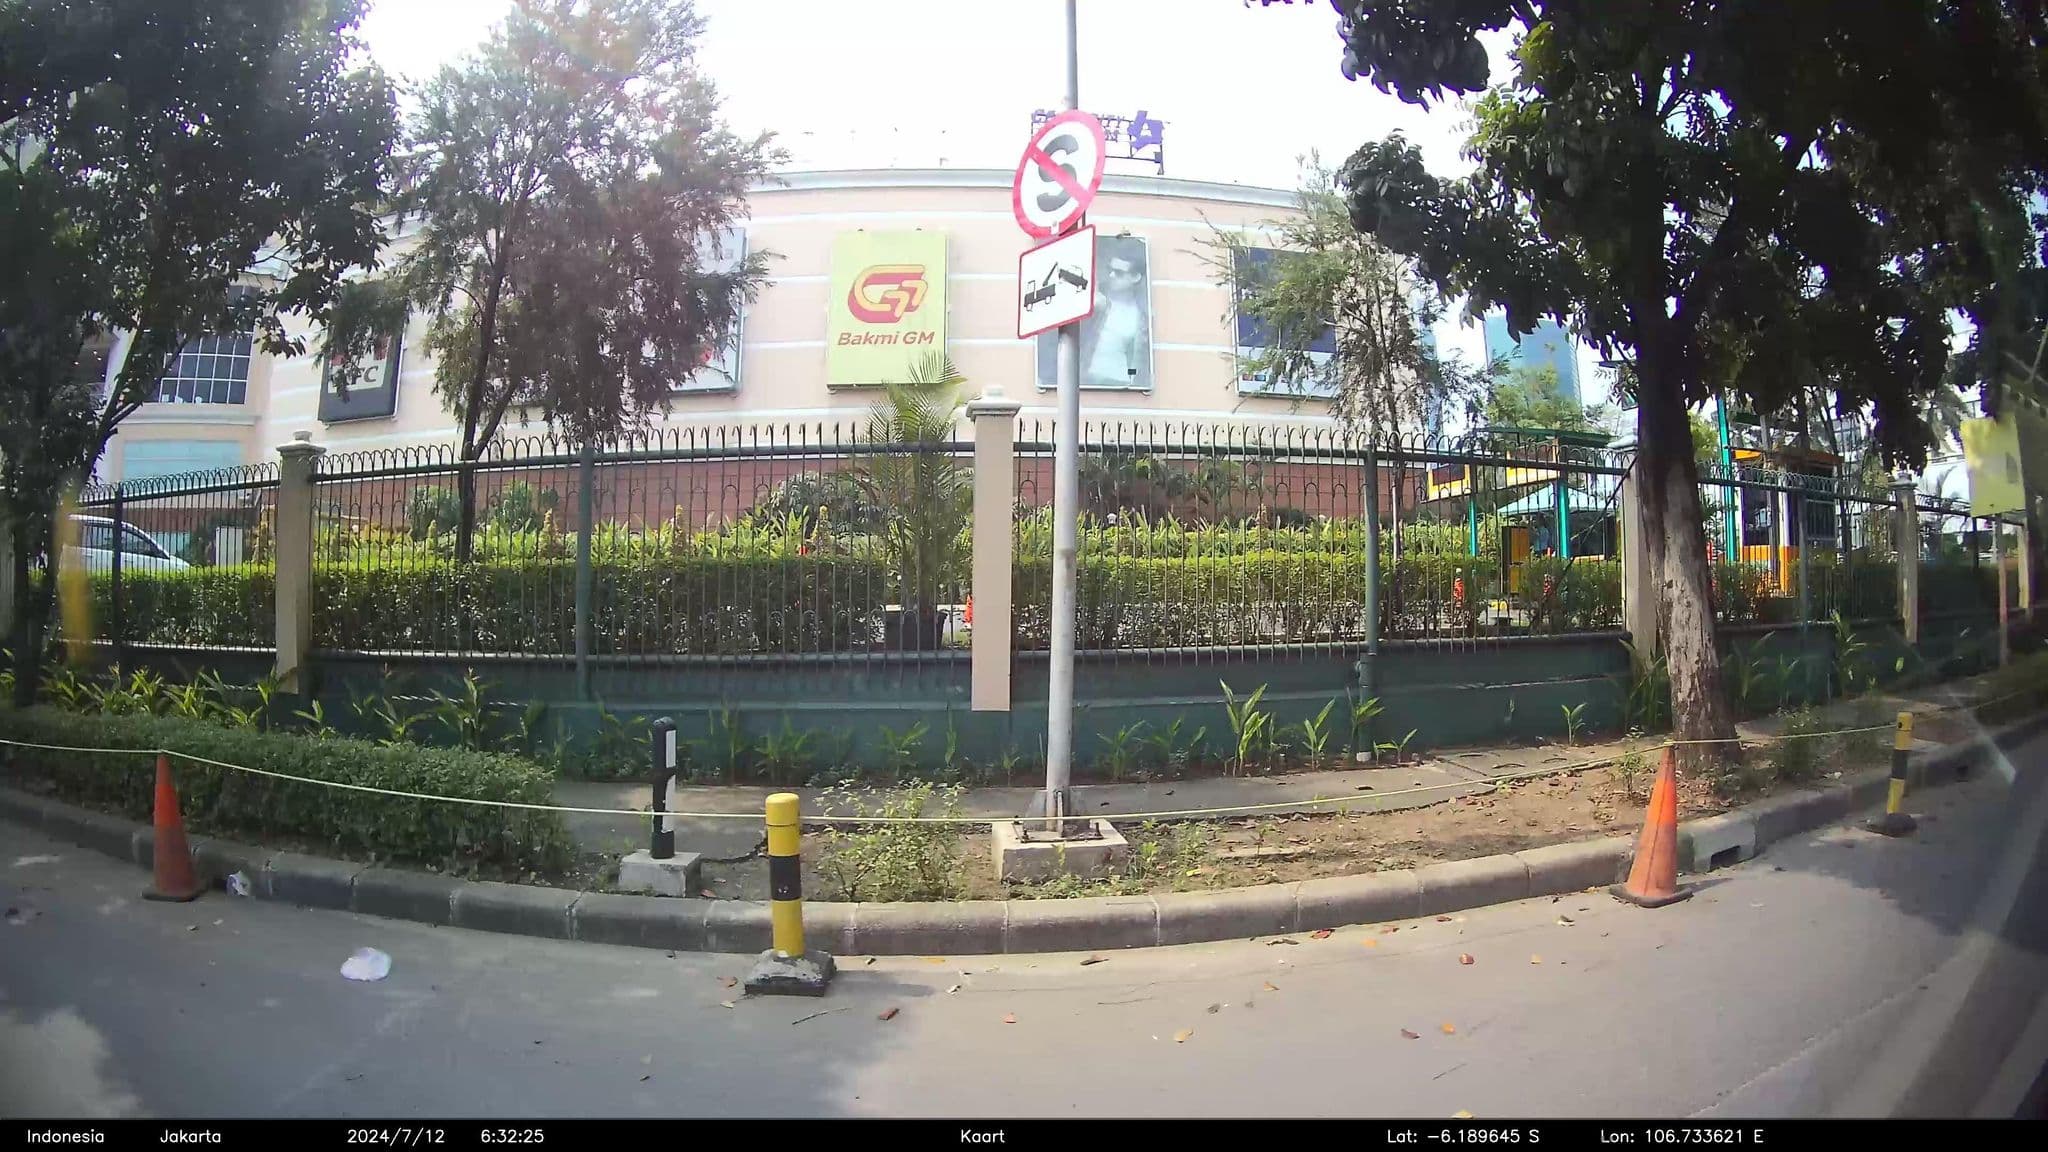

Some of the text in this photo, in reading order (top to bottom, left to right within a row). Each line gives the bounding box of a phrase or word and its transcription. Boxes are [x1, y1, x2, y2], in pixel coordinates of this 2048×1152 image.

[1036, 134, 1079, 213] S
[837, 330, 935, 346] Bakmi GM
